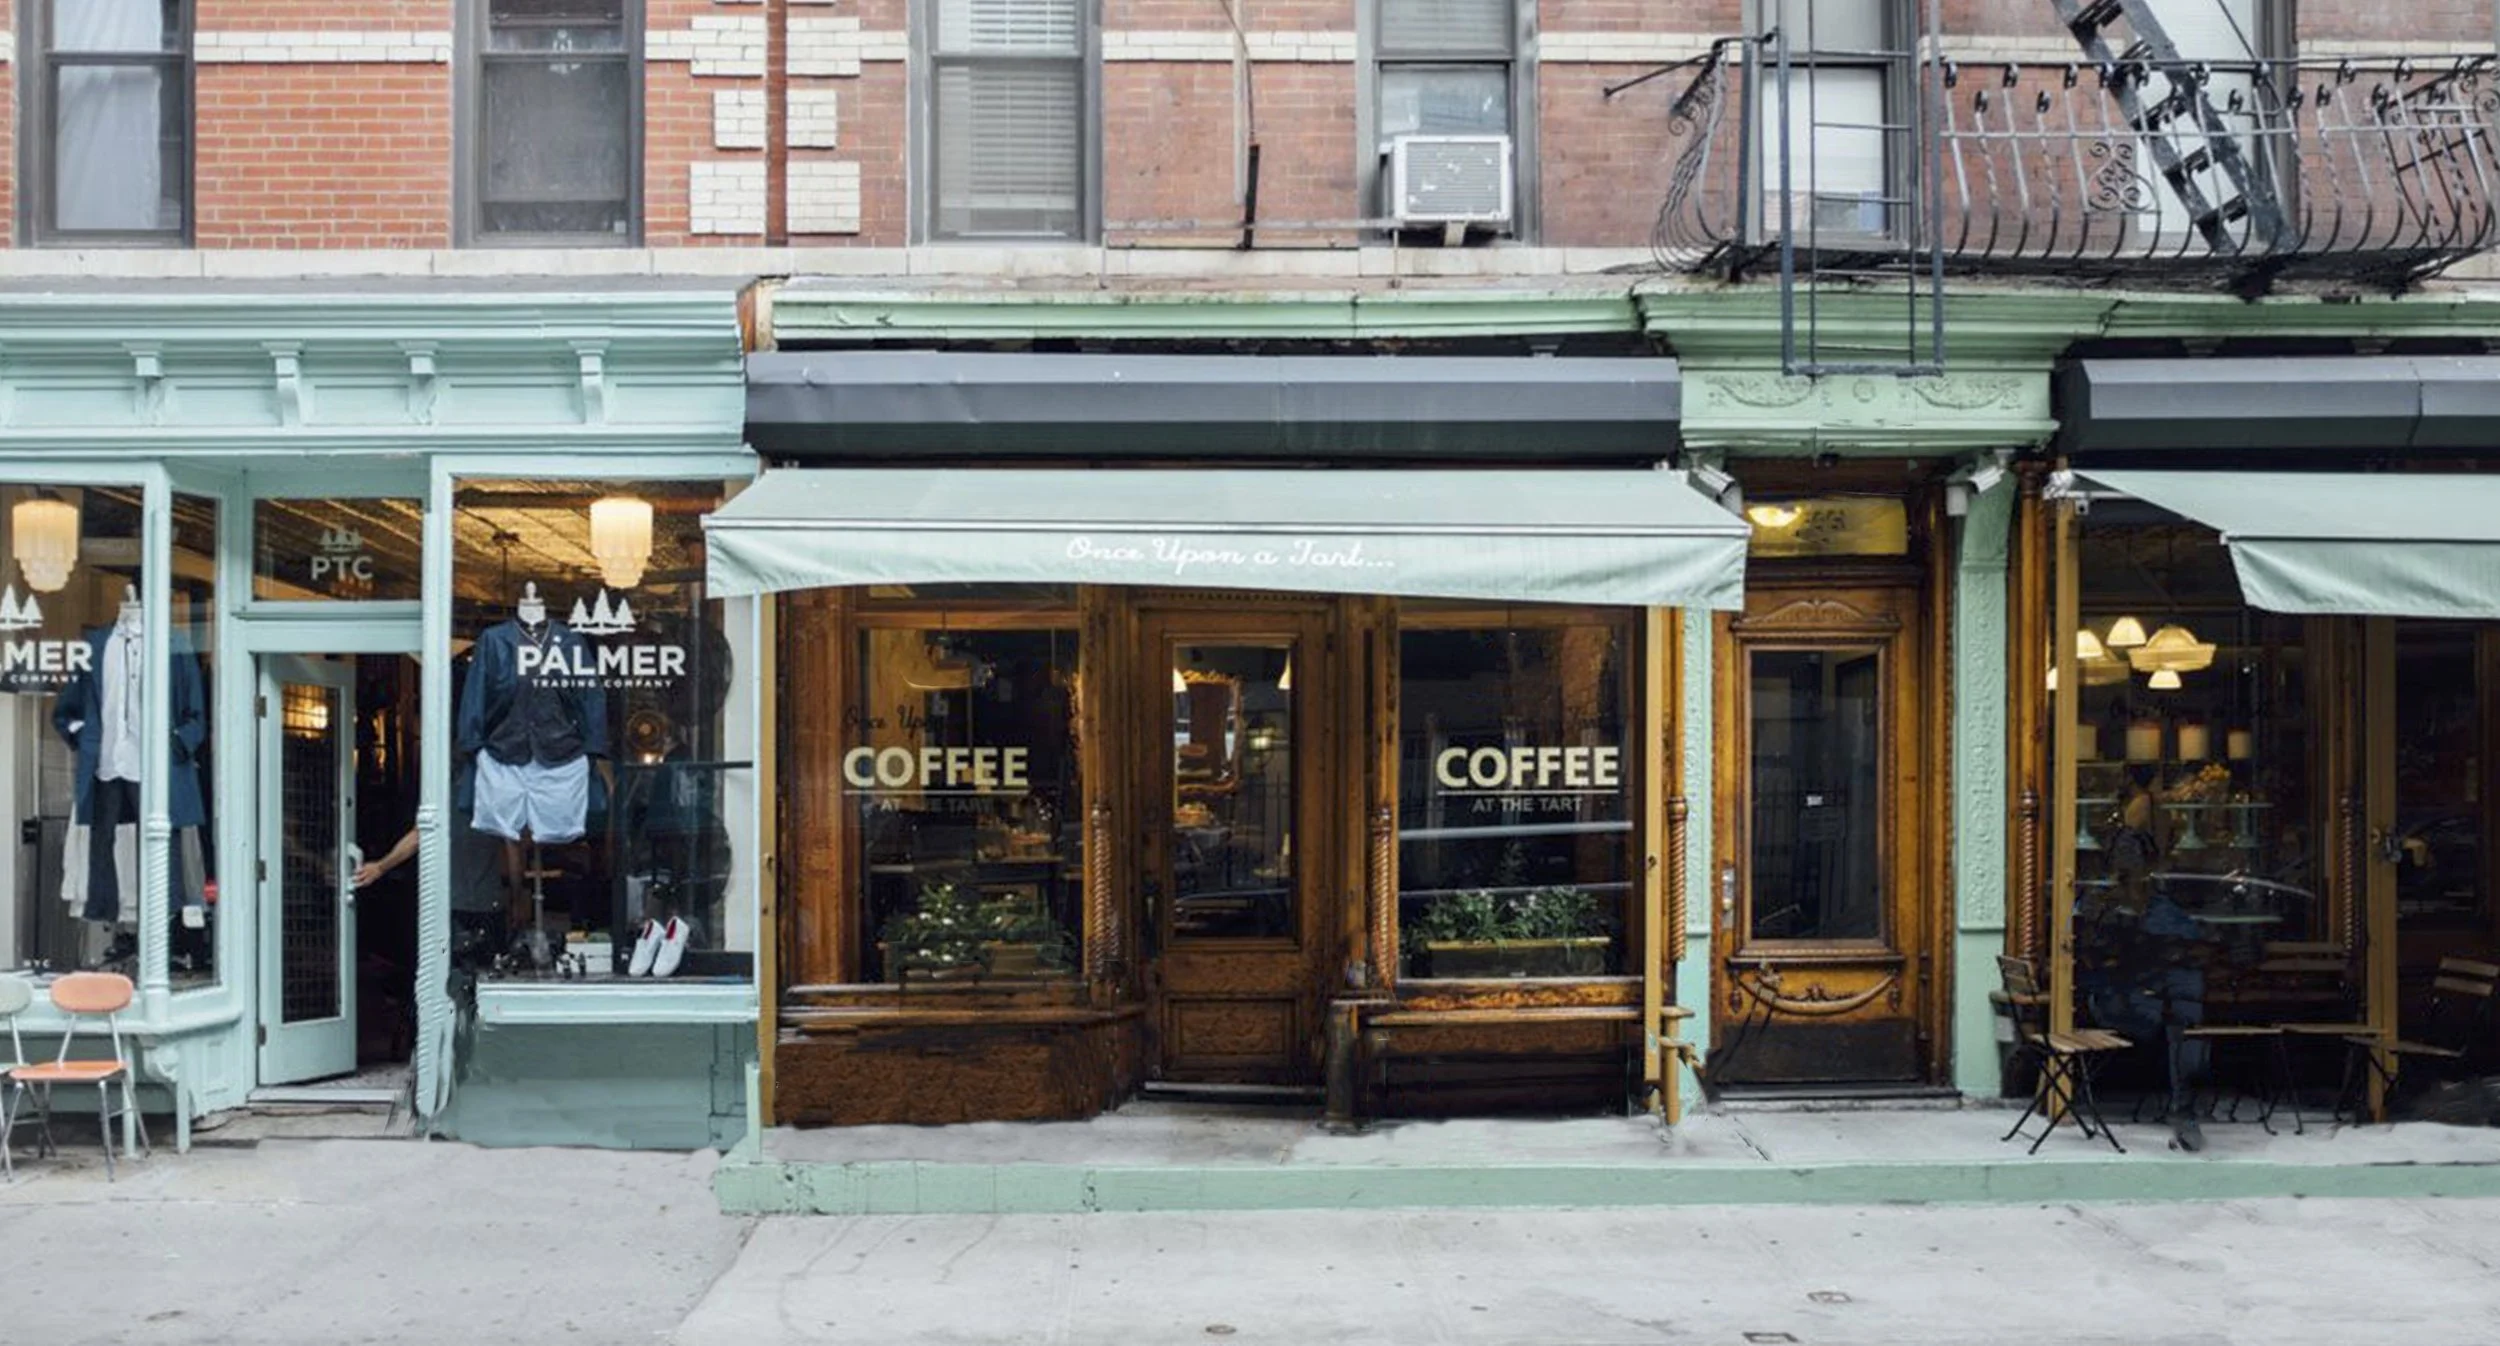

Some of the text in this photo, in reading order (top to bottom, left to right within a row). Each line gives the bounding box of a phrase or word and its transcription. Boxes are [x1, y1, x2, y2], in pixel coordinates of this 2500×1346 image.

[311, 556, 374, 580] PTC
[1066, 536, 1145, 560] Once
[1152, 537, 1246, 575] Upon
[1253, 551, 1279, 565] a
[0, 640, 93, 671] MER
[517, 645, 686, 676] PALMER
[9, 674, 79, 684] COMPANY
[532, 679, 673, 688] TRADING COMPANY
[843, 746, 1029, 788] COFFEE
[1436, 747, 1619, 788] COFFEE
[1472, 798, 1582, 813] AT THE TART
